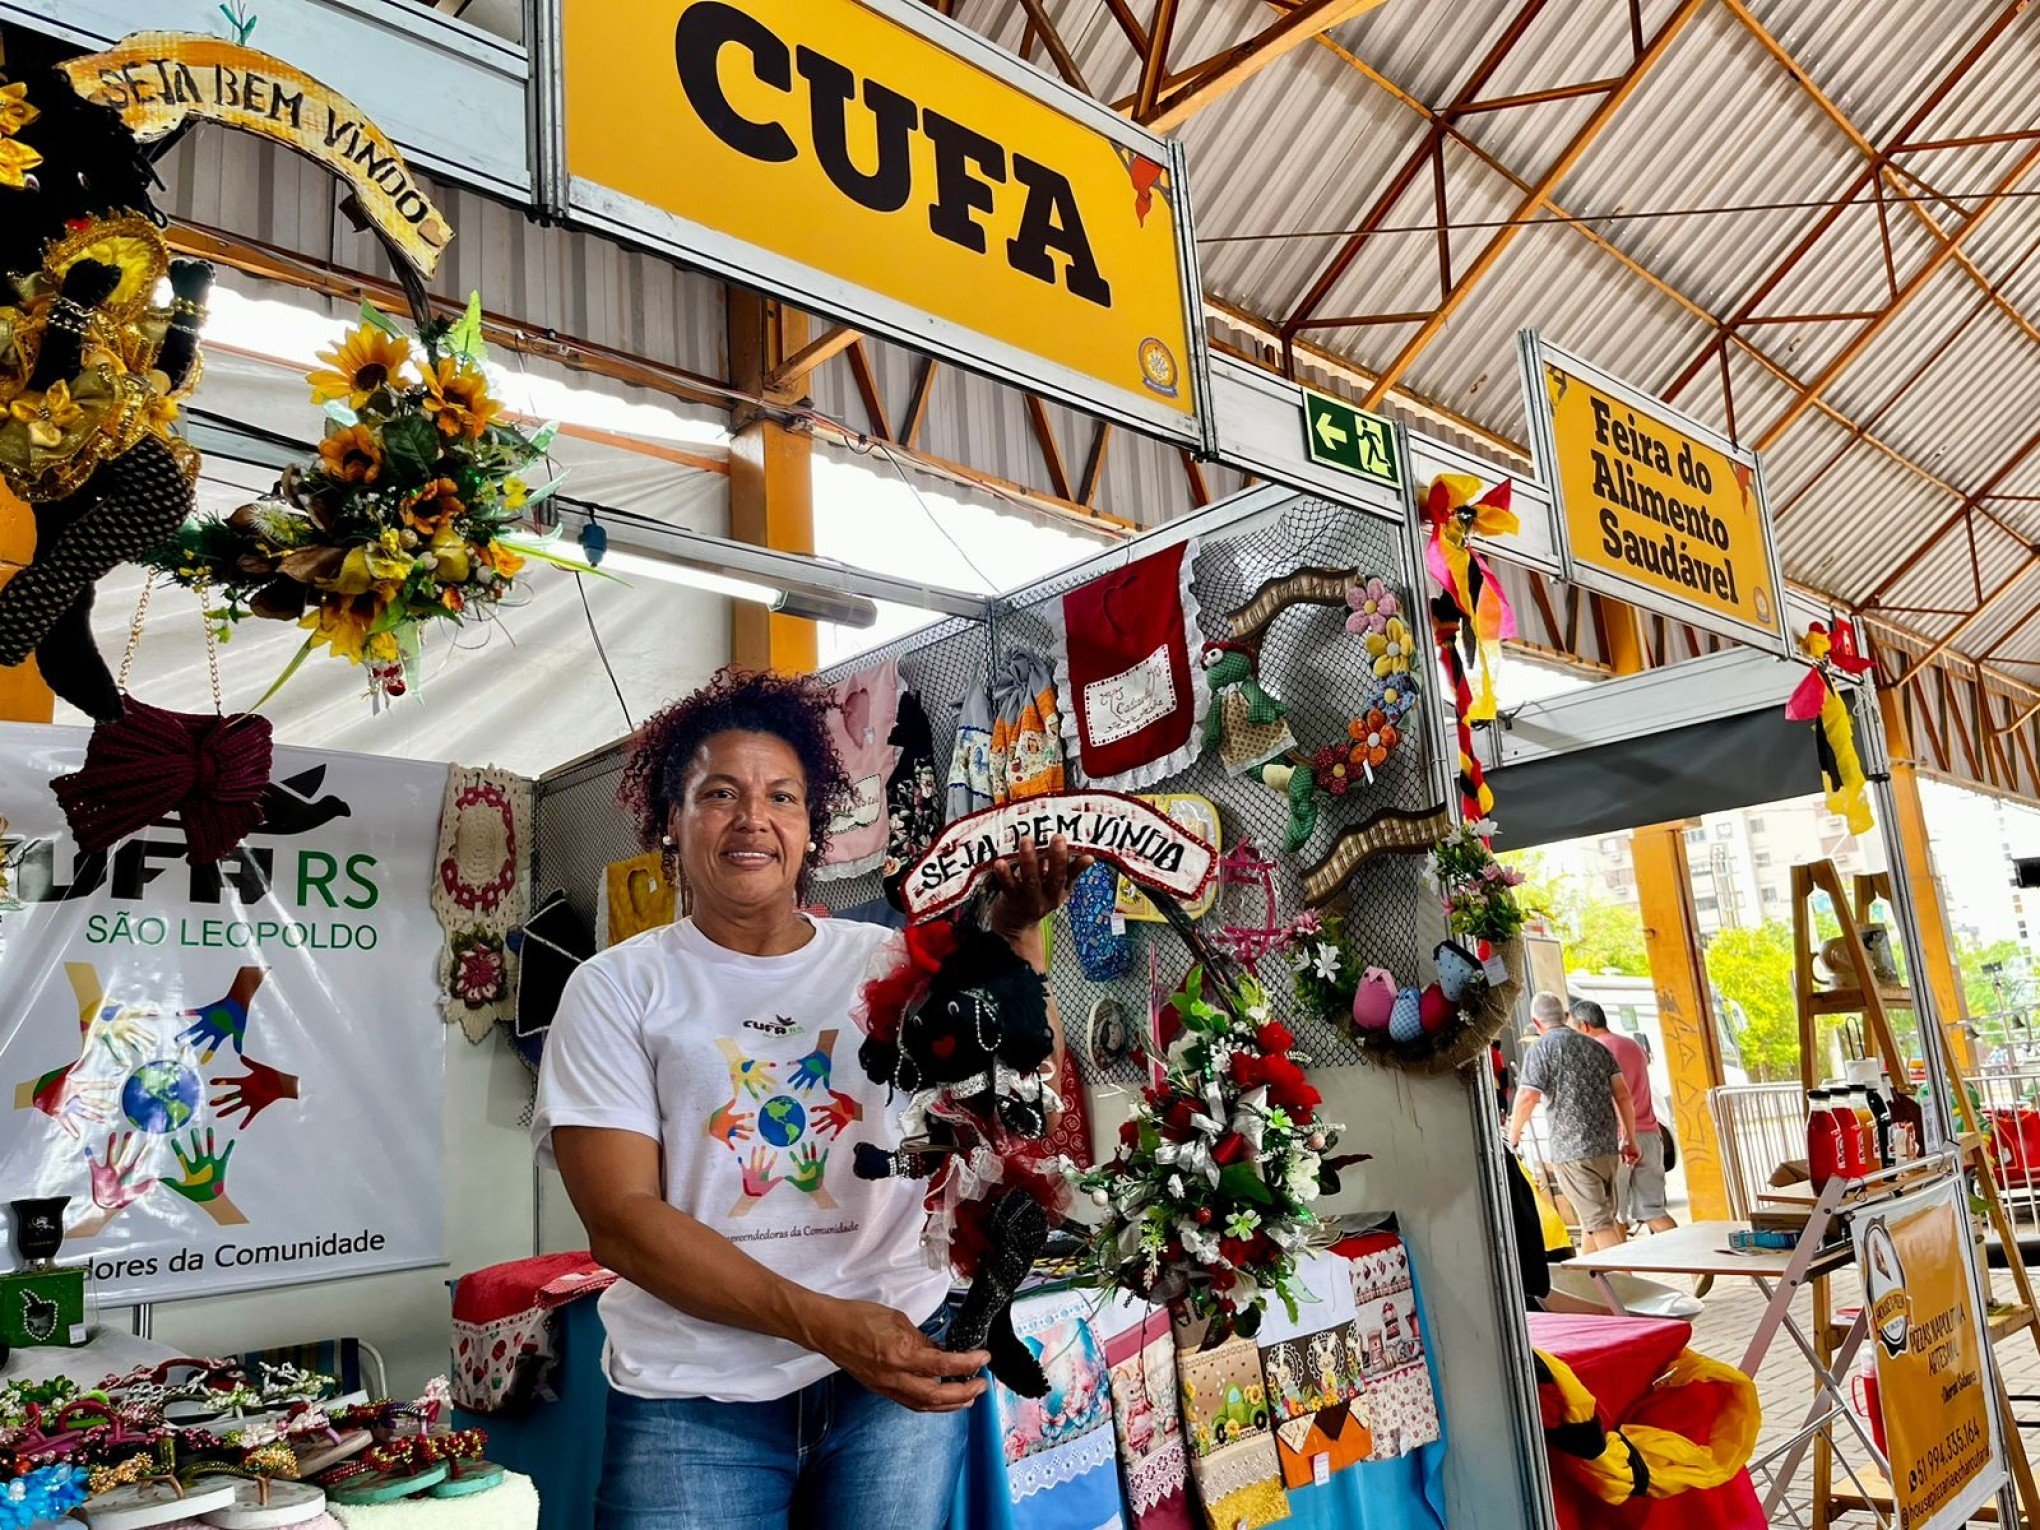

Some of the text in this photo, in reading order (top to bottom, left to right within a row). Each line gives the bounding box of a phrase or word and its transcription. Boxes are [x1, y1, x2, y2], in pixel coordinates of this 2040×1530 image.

[99, 58, 428, 224] SEJA BEM VINDO
[675, 1, 1111, 308] CUFA
[1590, 396, 1713, 495] Feira do
[1590, 448, 1730, 551] Alimento
[1598, 507, 1739, 604] Saudável
[0, 837, 380, 910] UFA RS
[921, 834, 998, 889] SEJA
[85, 911, 378, 950] SÃO LEOPOLDO
[743, 1020, 787, 1035] CUFA
[168, 1247, 204, 1273] da
[214, 1229, 385, 1269] Comunidade
